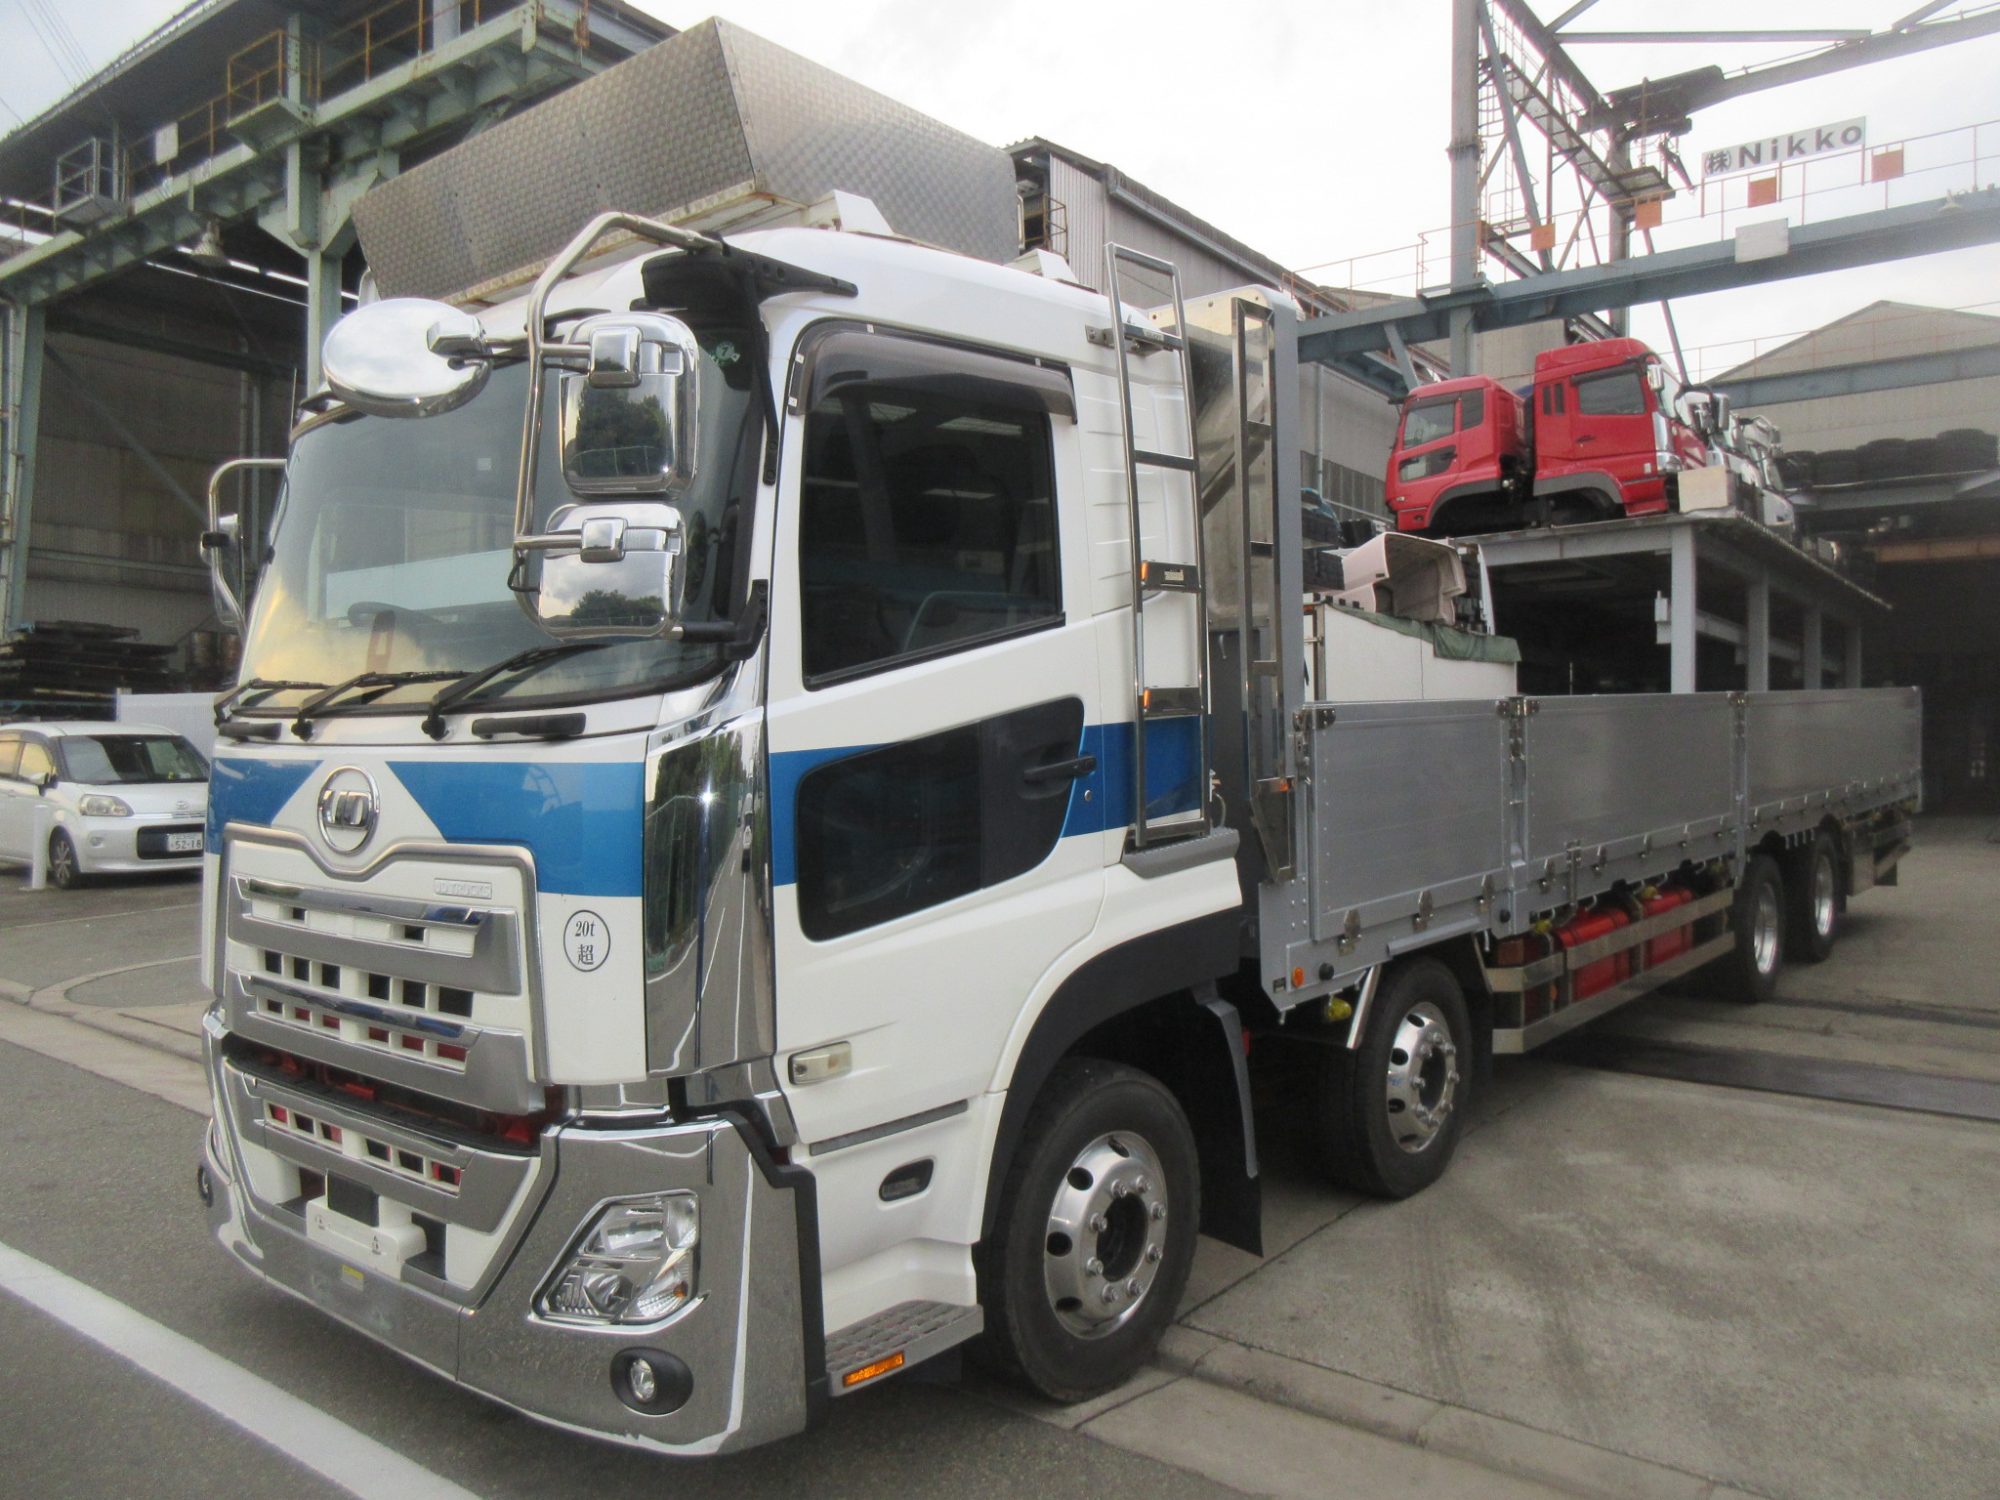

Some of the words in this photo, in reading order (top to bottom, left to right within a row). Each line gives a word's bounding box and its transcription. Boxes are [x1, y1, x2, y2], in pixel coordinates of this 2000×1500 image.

[1738, 125, 1862, 168] Nikko
[574, 920, 596, 937] 20t
[577, 943, 595, 966] 超
